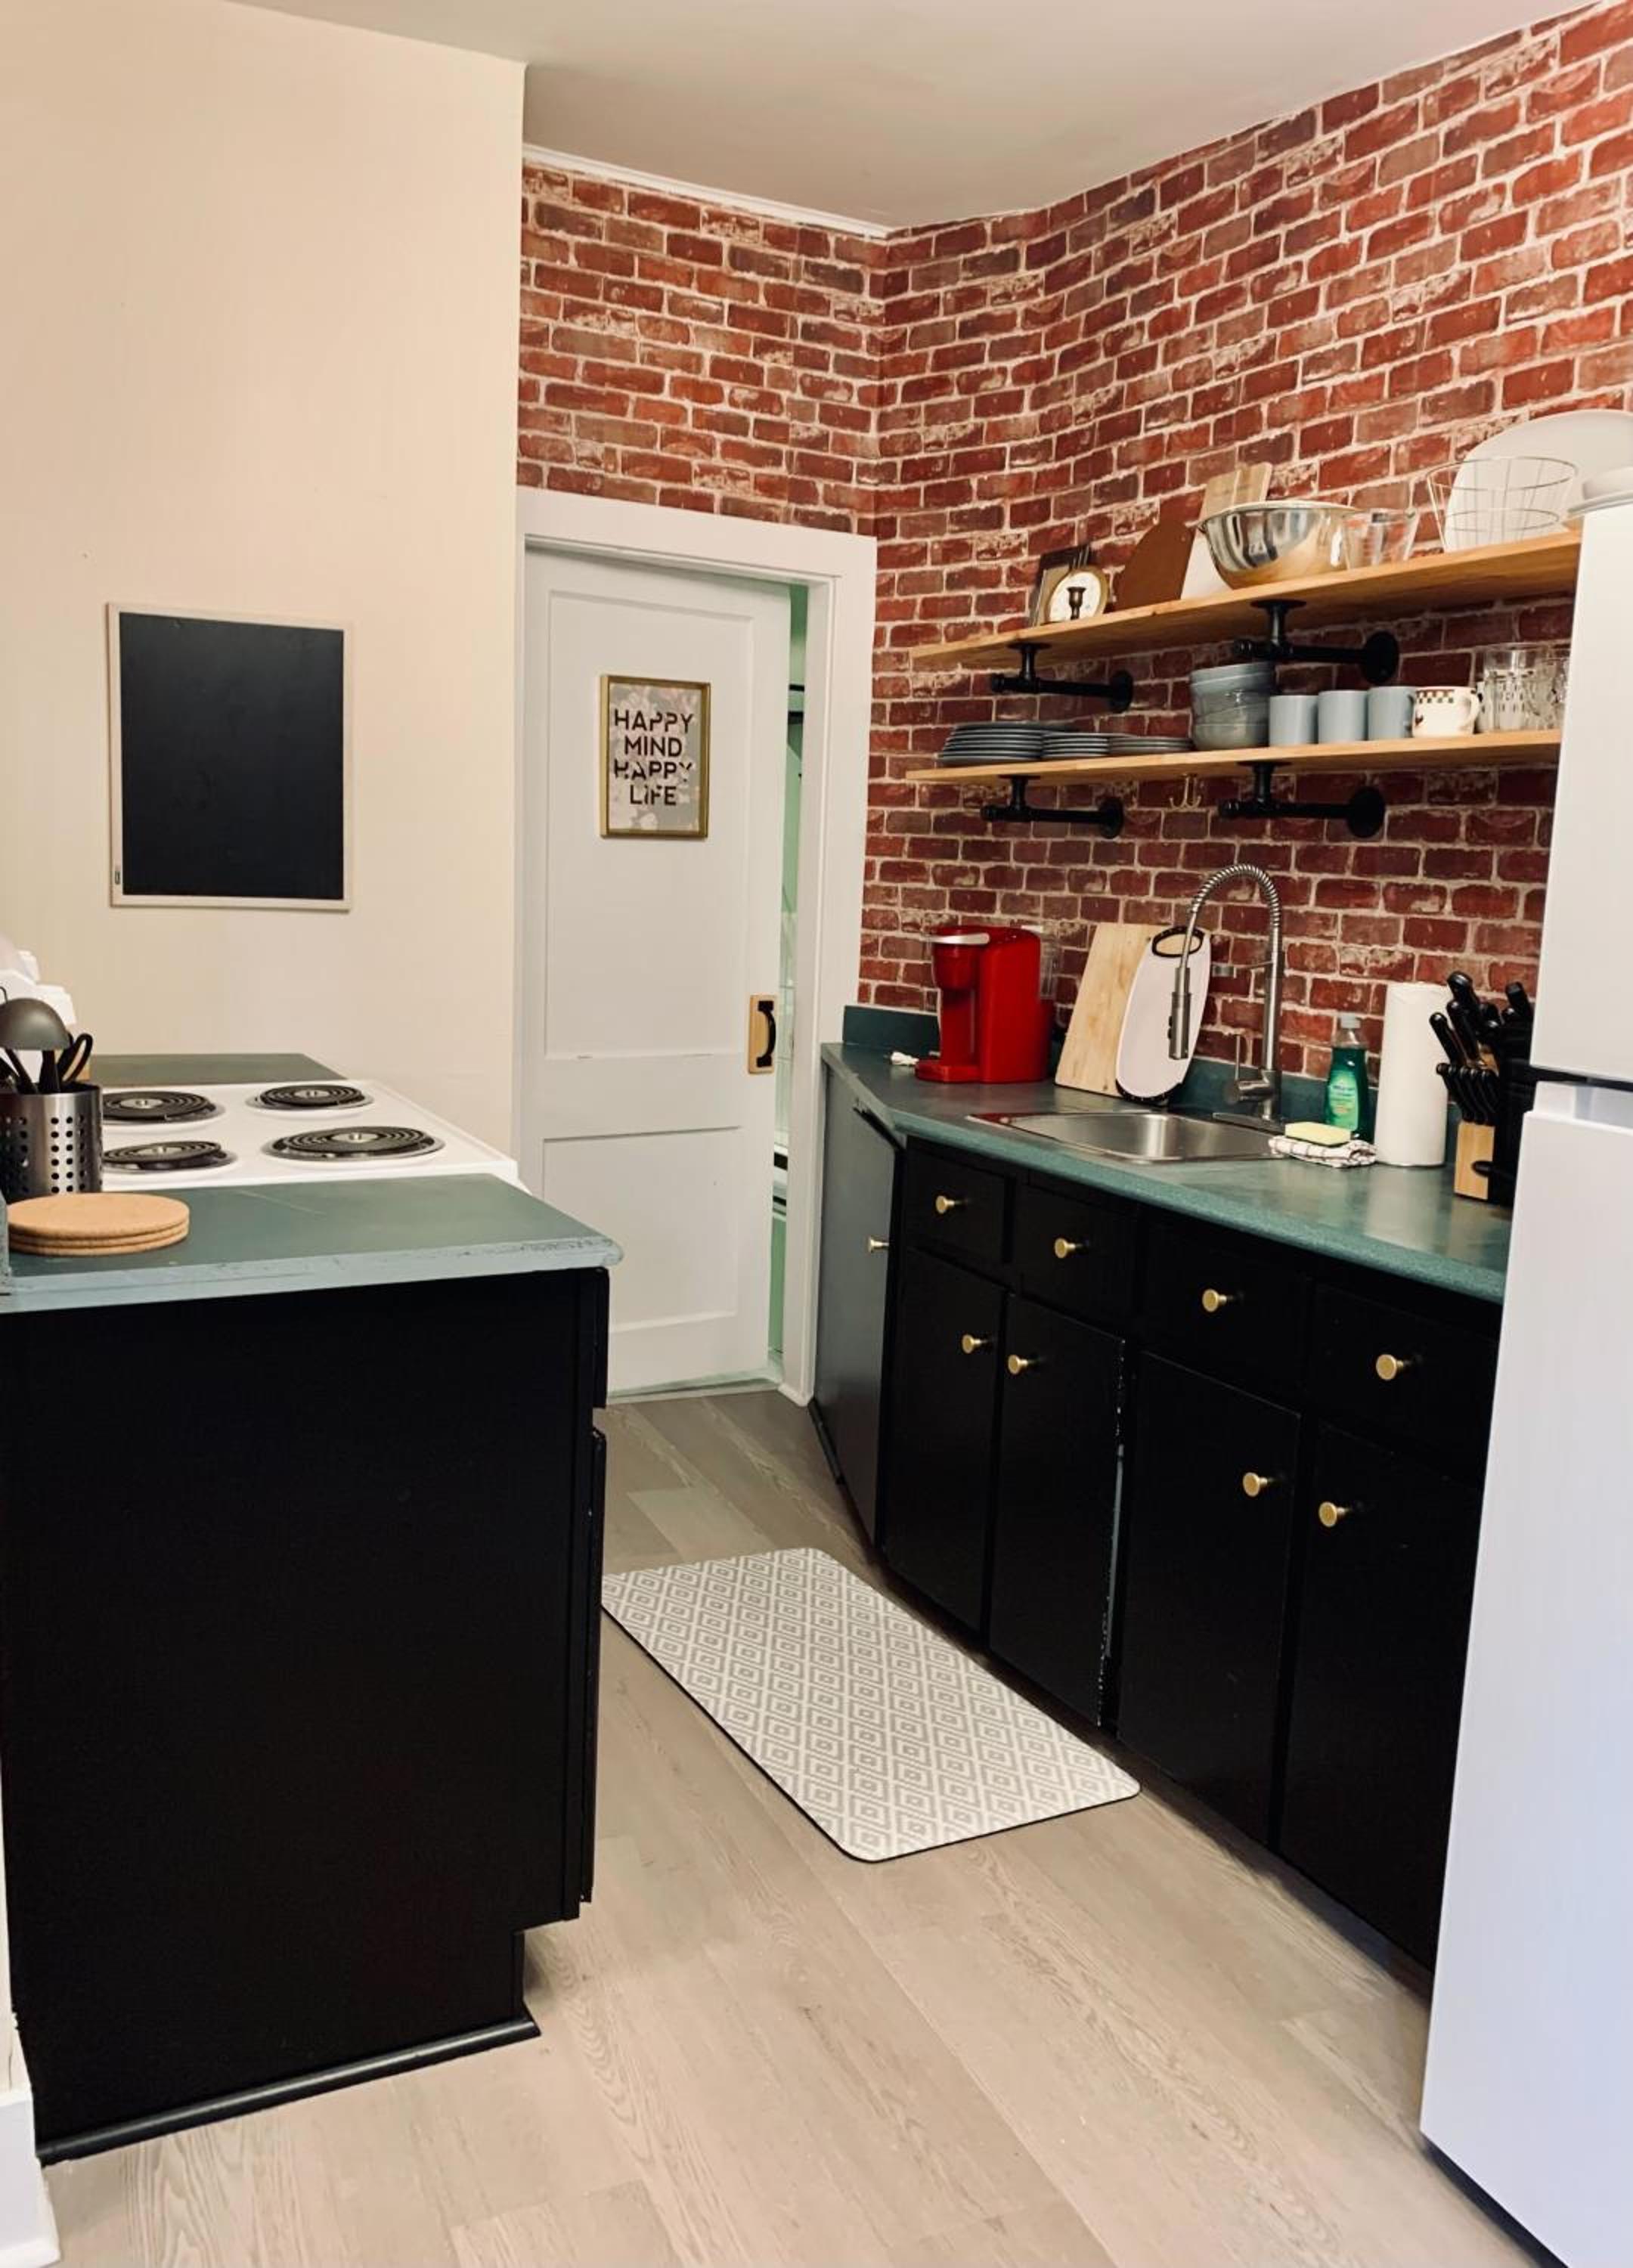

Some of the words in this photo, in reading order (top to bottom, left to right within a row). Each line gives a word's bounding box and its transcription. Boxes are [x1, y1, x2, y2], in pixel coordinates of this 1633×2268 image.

[615, 708, 694, 733] HAPPY
[624, 736, 683, 757] MIND
[614, 759, 693, 782] HAPPY
[630, 785, 677, 806] LIFE
